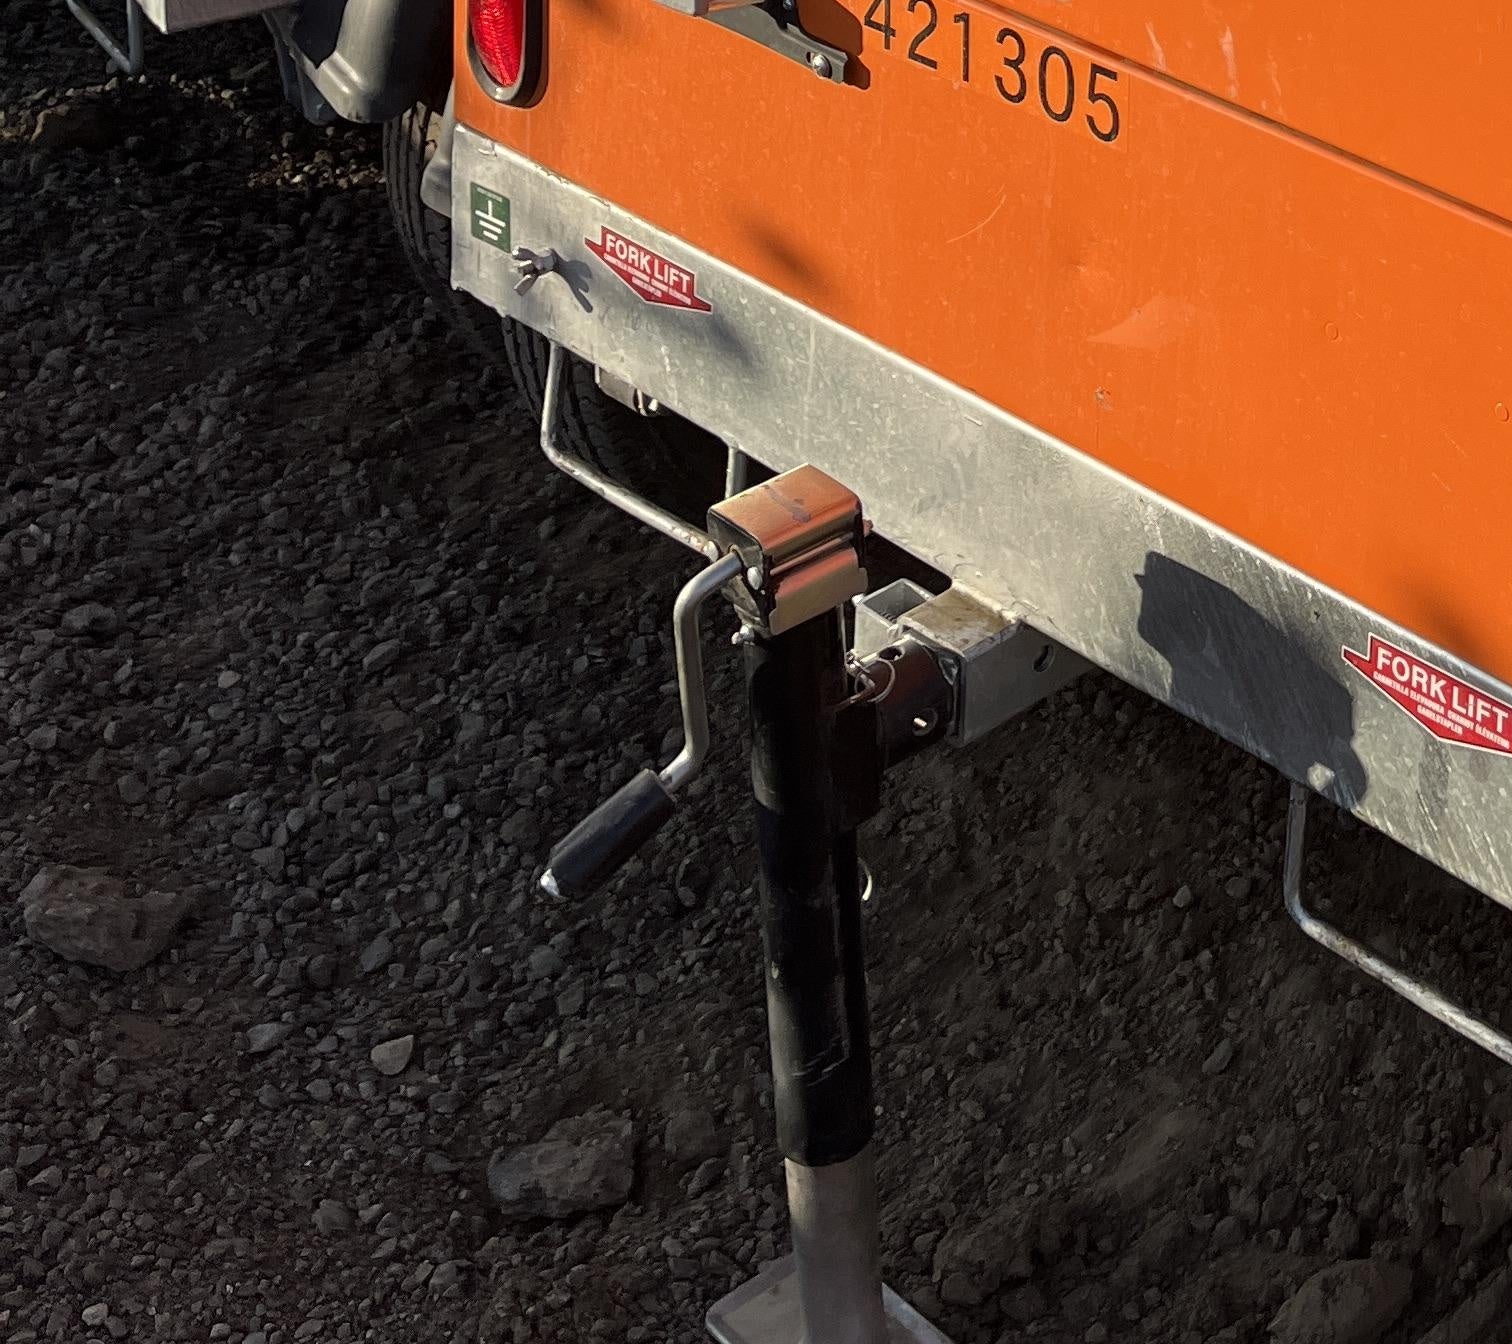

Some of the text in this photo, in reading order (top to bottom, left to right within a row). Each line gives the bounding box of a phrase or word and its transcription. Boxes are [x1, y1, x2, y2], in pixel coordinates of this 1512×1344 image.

[605, 233, 652, 275] FORK
[653, 258, 691, 294] LIFT
[1376, 646, 1509, 734] FORK LIFT
